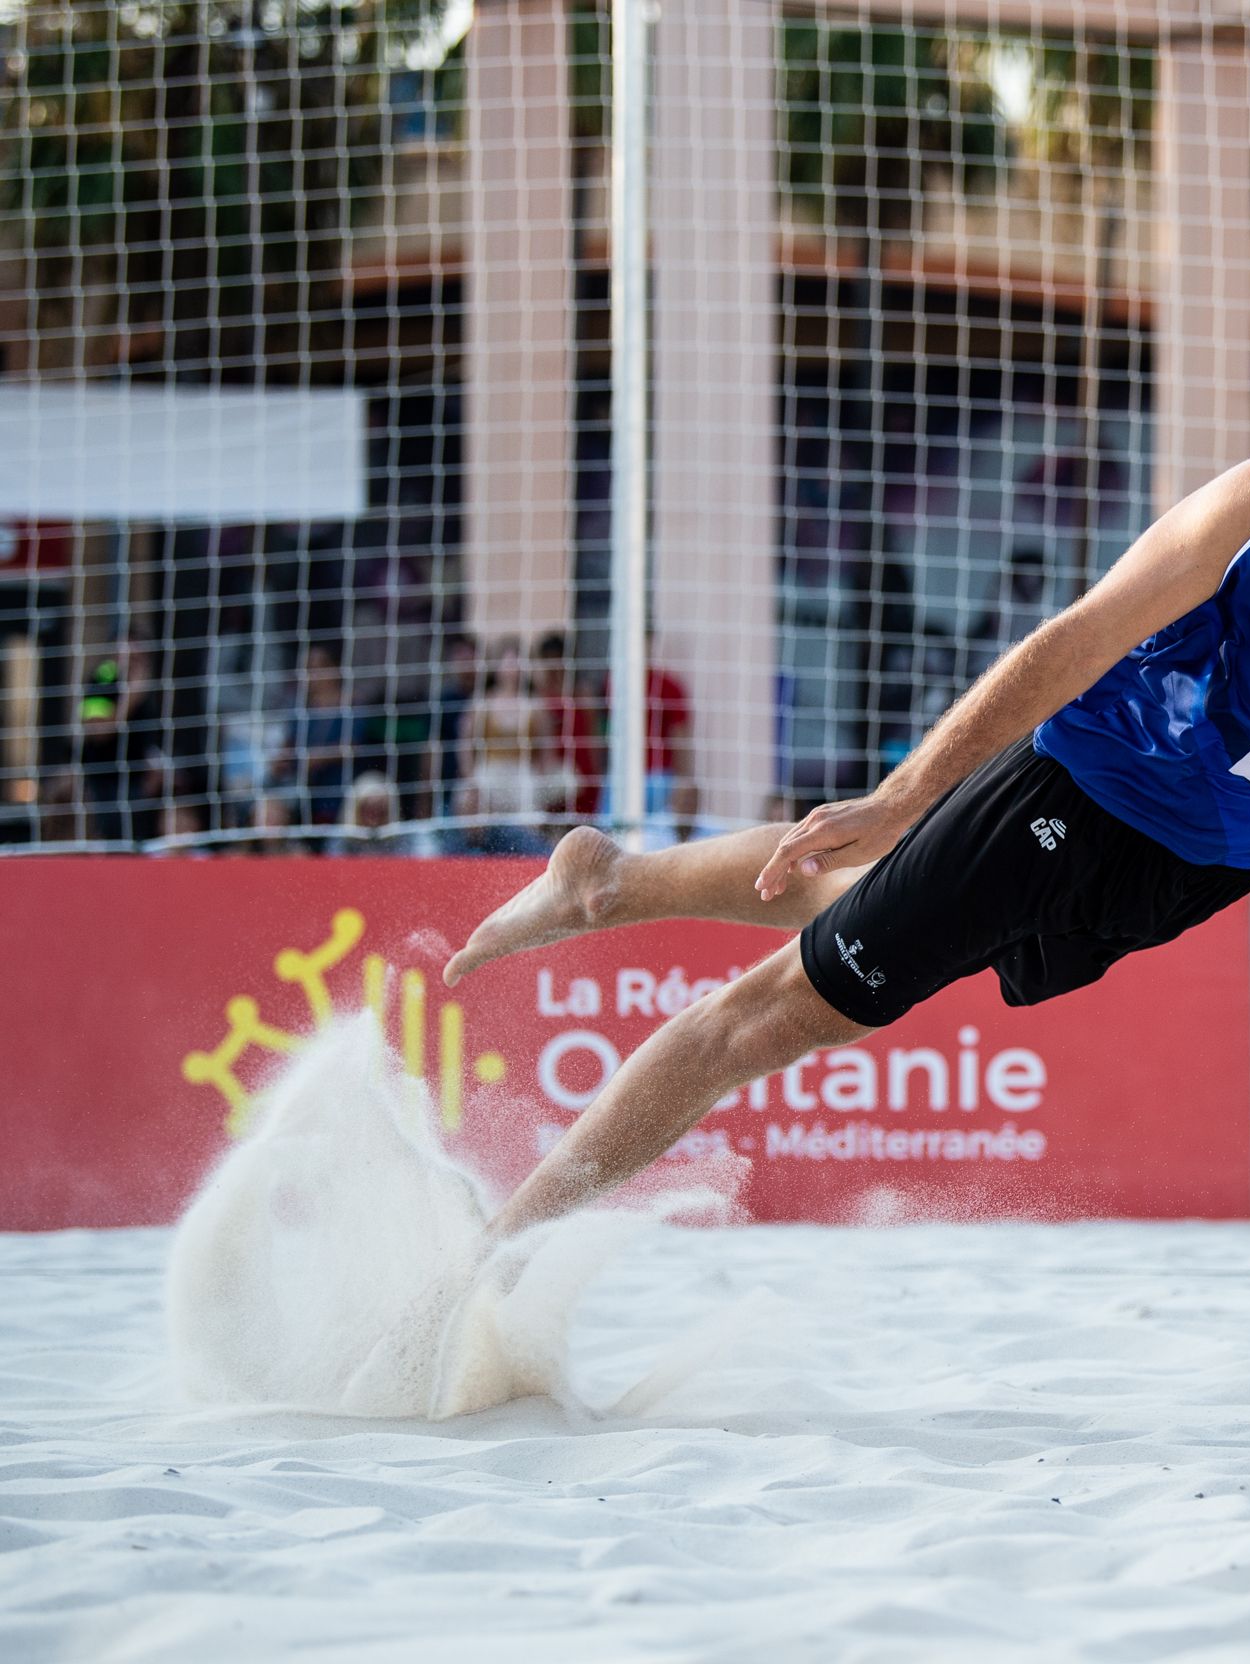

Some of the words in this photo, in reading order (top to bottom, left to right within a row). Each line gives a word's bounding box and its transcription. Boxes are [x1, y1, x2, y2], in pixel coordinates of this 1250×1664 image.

[1030, 817, 1057, 851] CAP
[537, 968, 601, 1018] La
[765, 1122, 1047, 1161] Méditerranée
